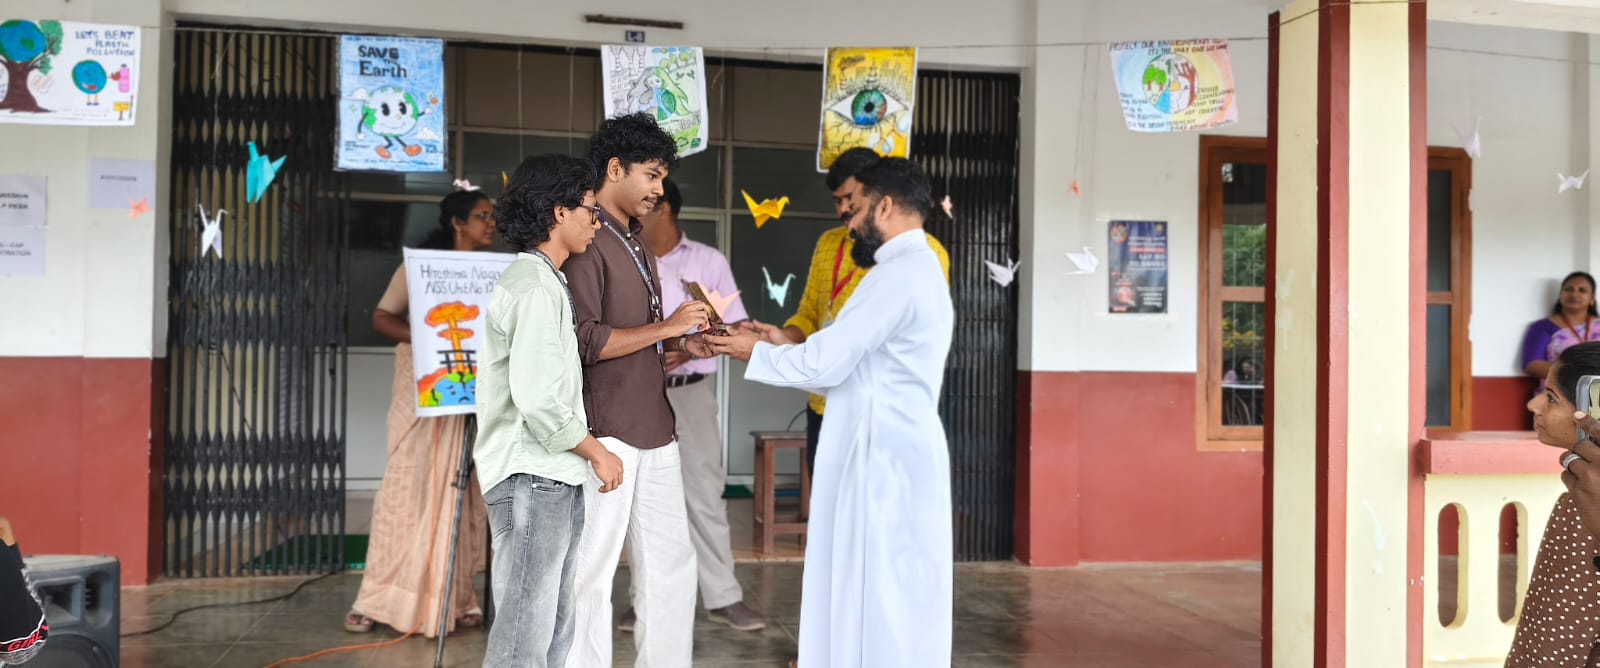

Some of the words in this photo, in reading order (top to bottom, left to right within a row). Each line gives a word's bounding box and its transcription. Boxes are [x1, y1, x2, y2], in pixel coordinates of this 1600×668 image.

[104, 30, 135, 40] BEAT
[358, 44, 400, 60] SAVE
[359, 59, 408, 78] Earth
[420, 263, 468, 280] Hiroshima
[425, 281, 447, 295] NSS
[448, 281, 469, 295] Unit
[7, 630, 44, 652] GIRL
